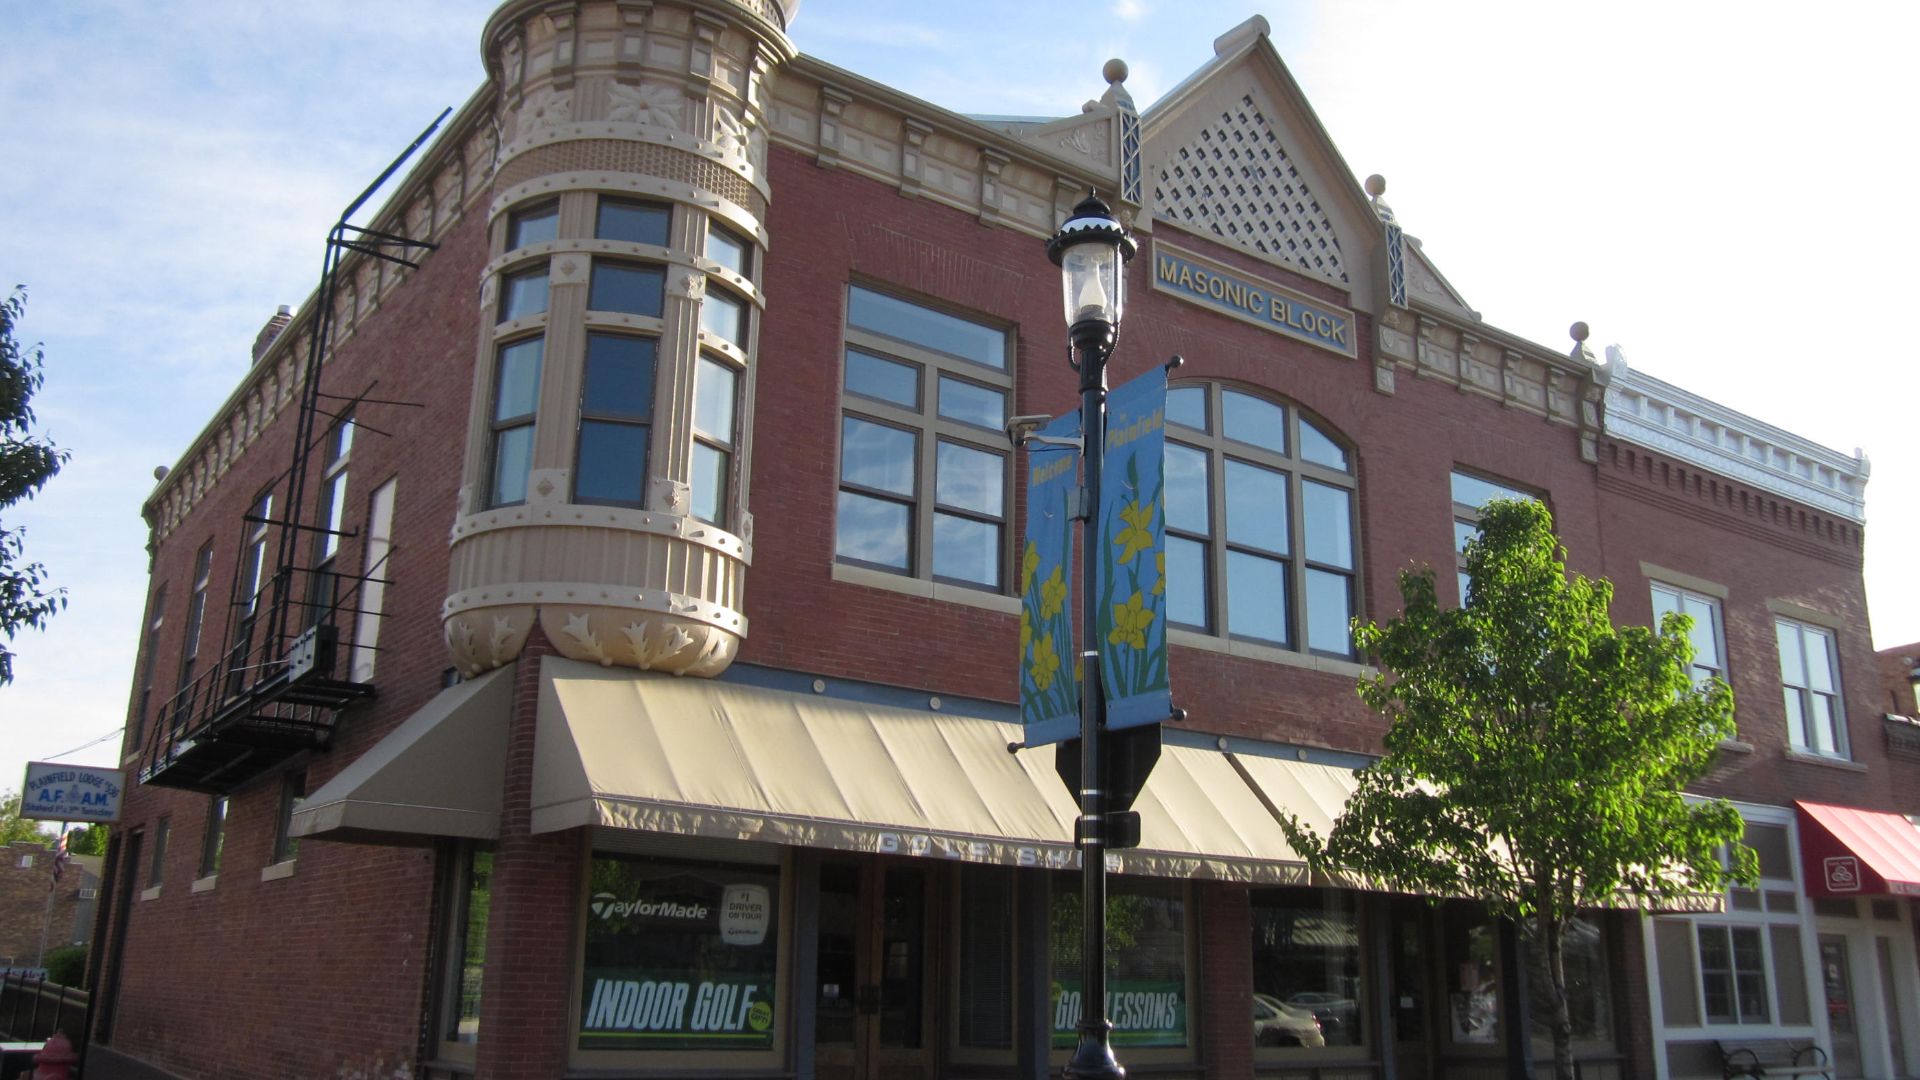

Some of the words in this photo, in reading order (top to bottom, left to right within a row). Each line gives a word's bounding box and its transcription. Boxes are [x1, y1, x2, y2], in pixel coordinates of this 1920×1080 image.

[1159, 256, 1264, 313] MASONIC
[1270, 297, 1345, 344] BLOCK
[29, 771, 76, 791] PLAINFIELD
[878, 832, 988, 862] GOLF
[1017, 847, 1120, 873] SHP
[591, 892, 708, 919] TaylorMade
[728, 911, 740, 919] ON
[741, 912, 762, 920] TOUR
[729, 903, 762, 912] DRIVER
[585, 978, 689, 1031] INDOOR
[690, 981, 757, 1031] GOLF
